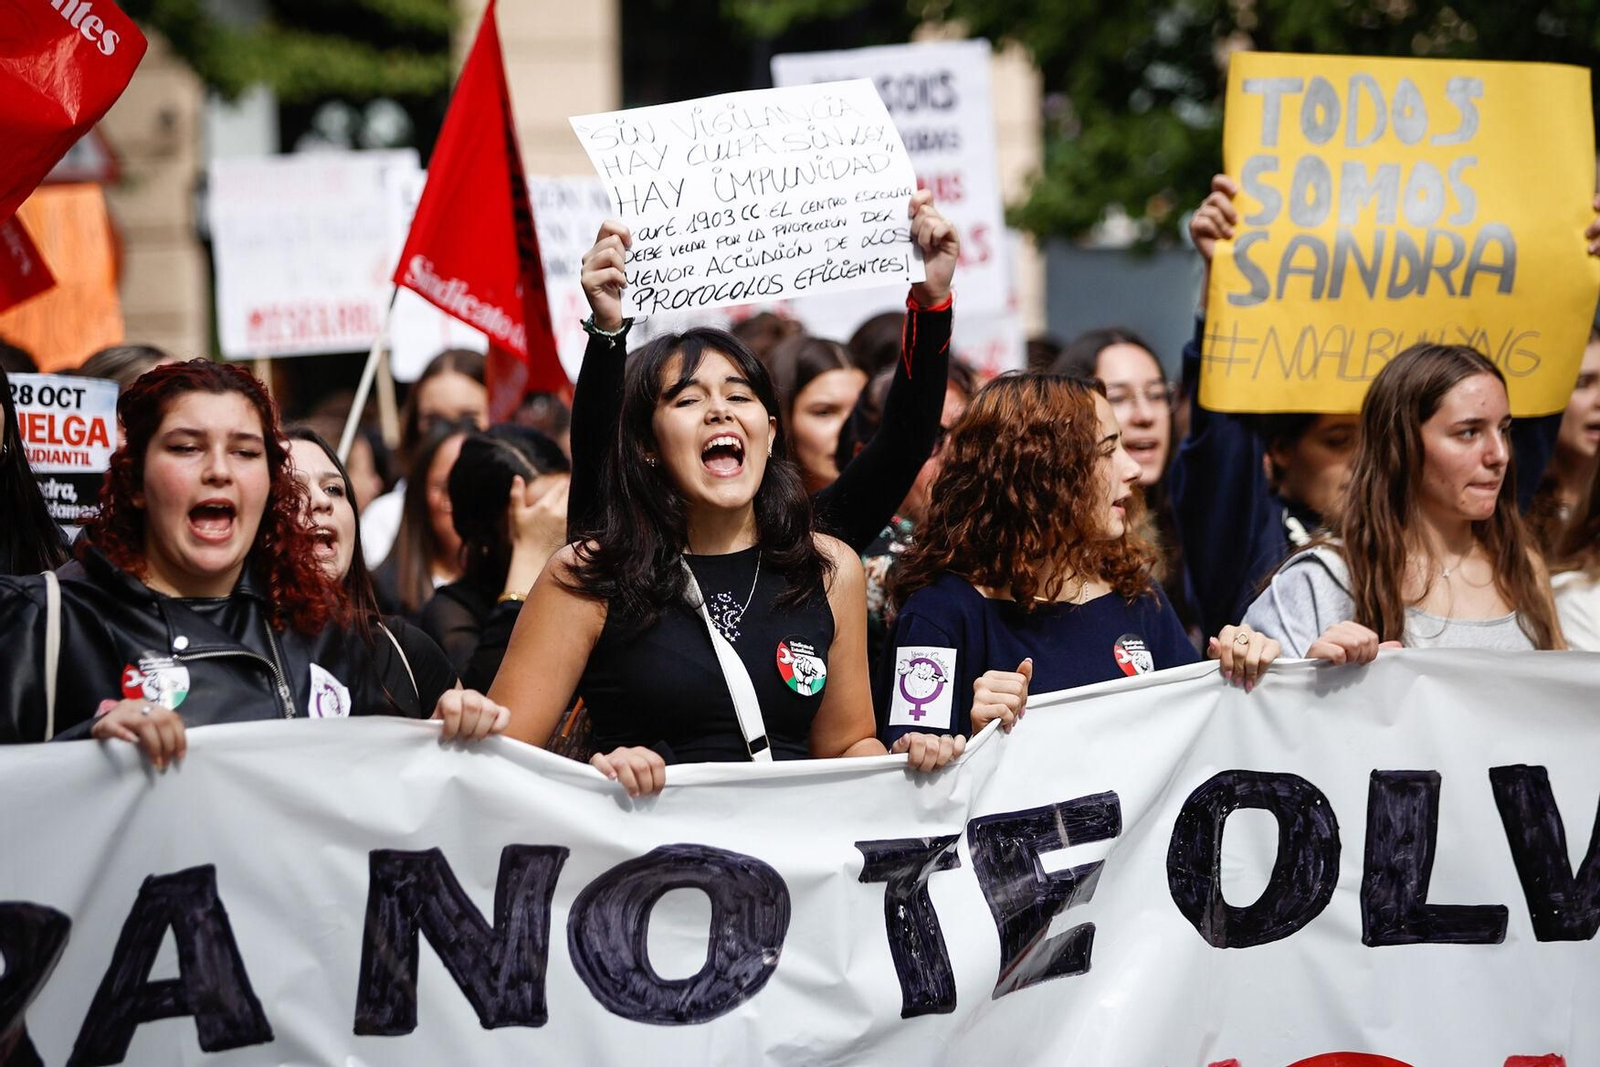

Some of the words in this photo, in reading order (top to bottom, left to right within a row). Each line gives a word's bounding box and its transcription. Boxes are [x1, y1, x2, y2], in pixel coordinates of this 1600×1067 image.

[1242, 72, 1484, 148] TODOS
[602, 145, 668, 178] HAY
[614, 177, 685, 217] HAY
[686, 208, 736, 234] 1903
[769, 200, 793, 218] EL
[800, 196, 848, 216] CENTRO
[854, 186, 913, 204] ESCOLAR
[1240, 153, 1479, 228] SOMOS
[670, 239, 706, 258] VELAR
[716, 233, 741, 250] POR
[747, 228, 766, 243] LA
[860, 209, 895, 224] DEL
[825, 235, 849, 252] DE
[861, 227, 914, 249] LOS
[631, 273, 785, 315] PROTOCOLOS
[793, 252, 910, 291] EFICIENTES!
[1226, 222, 1518, 308] SANDRA
[11, 384, 33, 406] 28
[38, 386, 86, 409] OCT
[354, 843, 792, 1037] NO
[855, 790, 1122, 1019] TE
